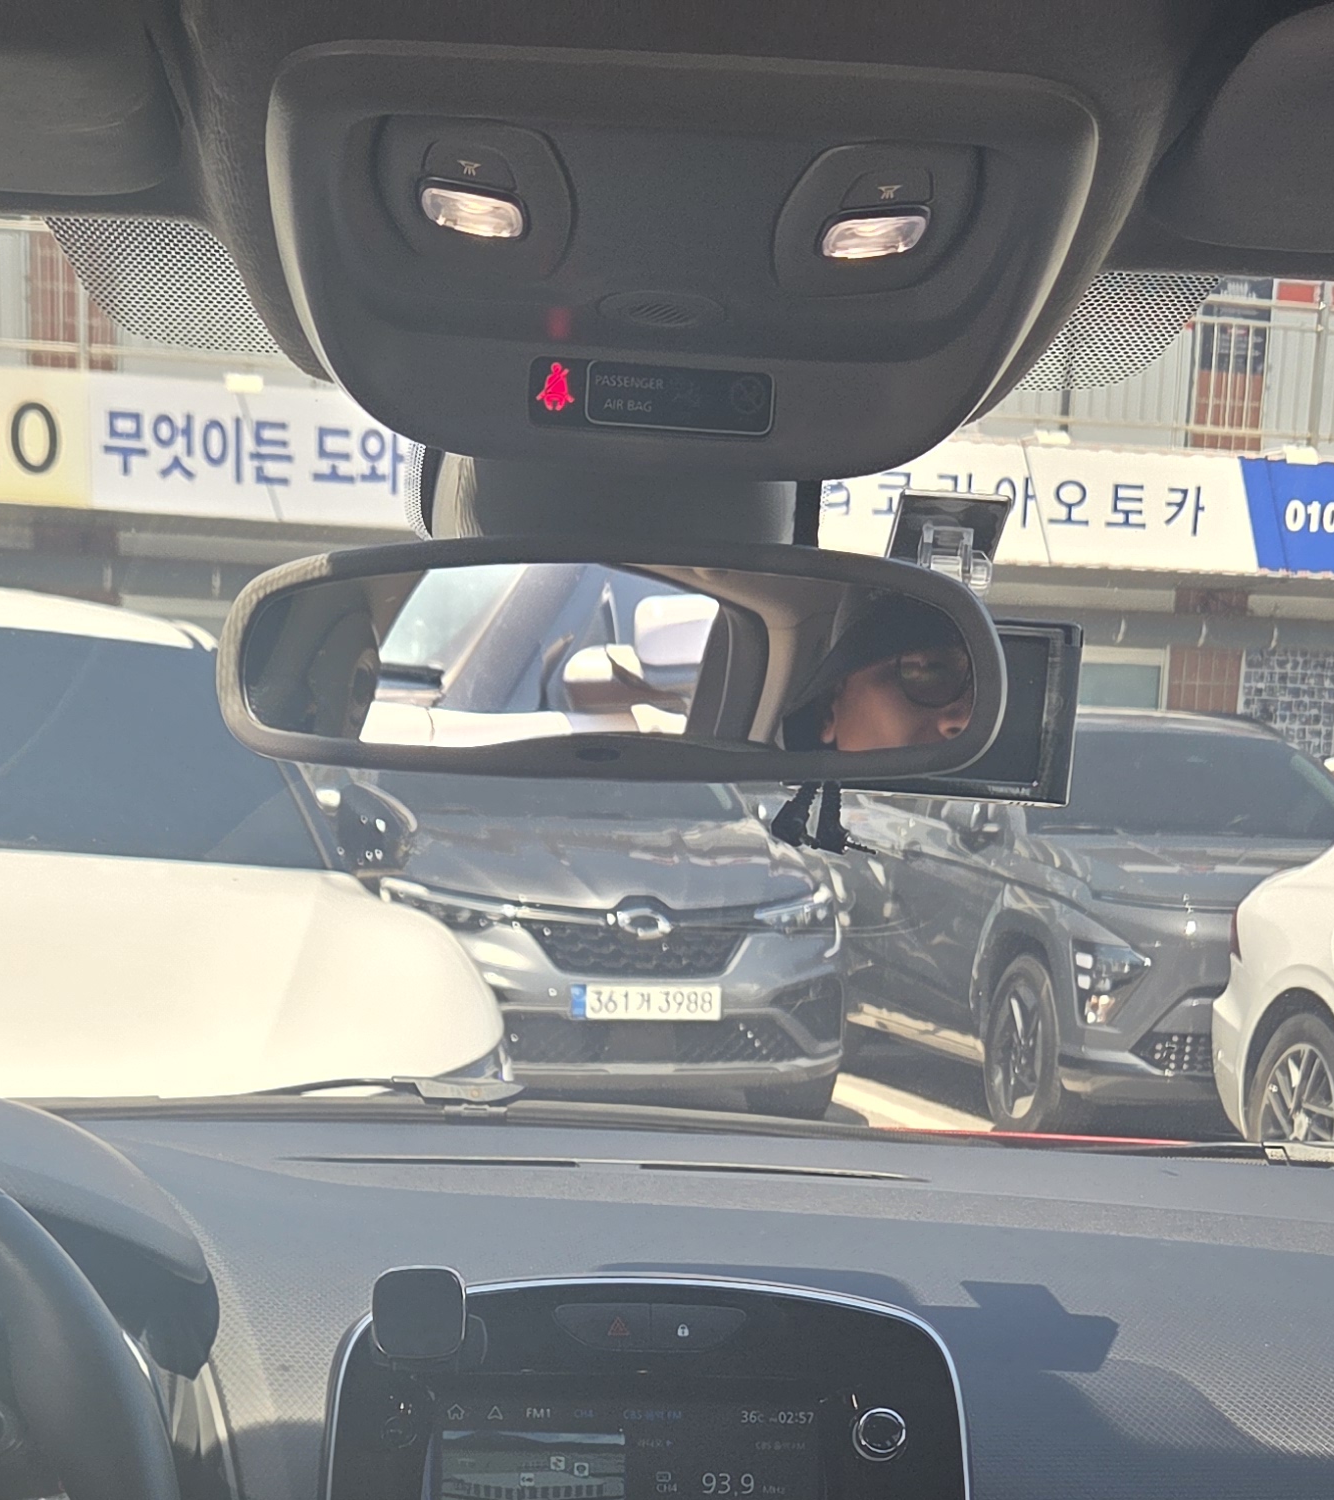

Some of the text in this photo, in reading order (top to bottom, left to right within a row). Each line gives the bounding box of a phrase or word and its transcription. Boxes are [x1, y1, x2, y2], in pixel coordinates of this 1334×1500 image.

[594, 373, 664, 391] PASSENGER
[603, 398, 653, 413] AIR BAG
[103, 409, 405, 495] 무엇이든 도와
[658, 990, 714, 1014] 3988
[525, 1407, 552, 1419] FM1
[777, 1411, 815, 1425] 02:57
[655, 1483, 679, 1494] CH4
